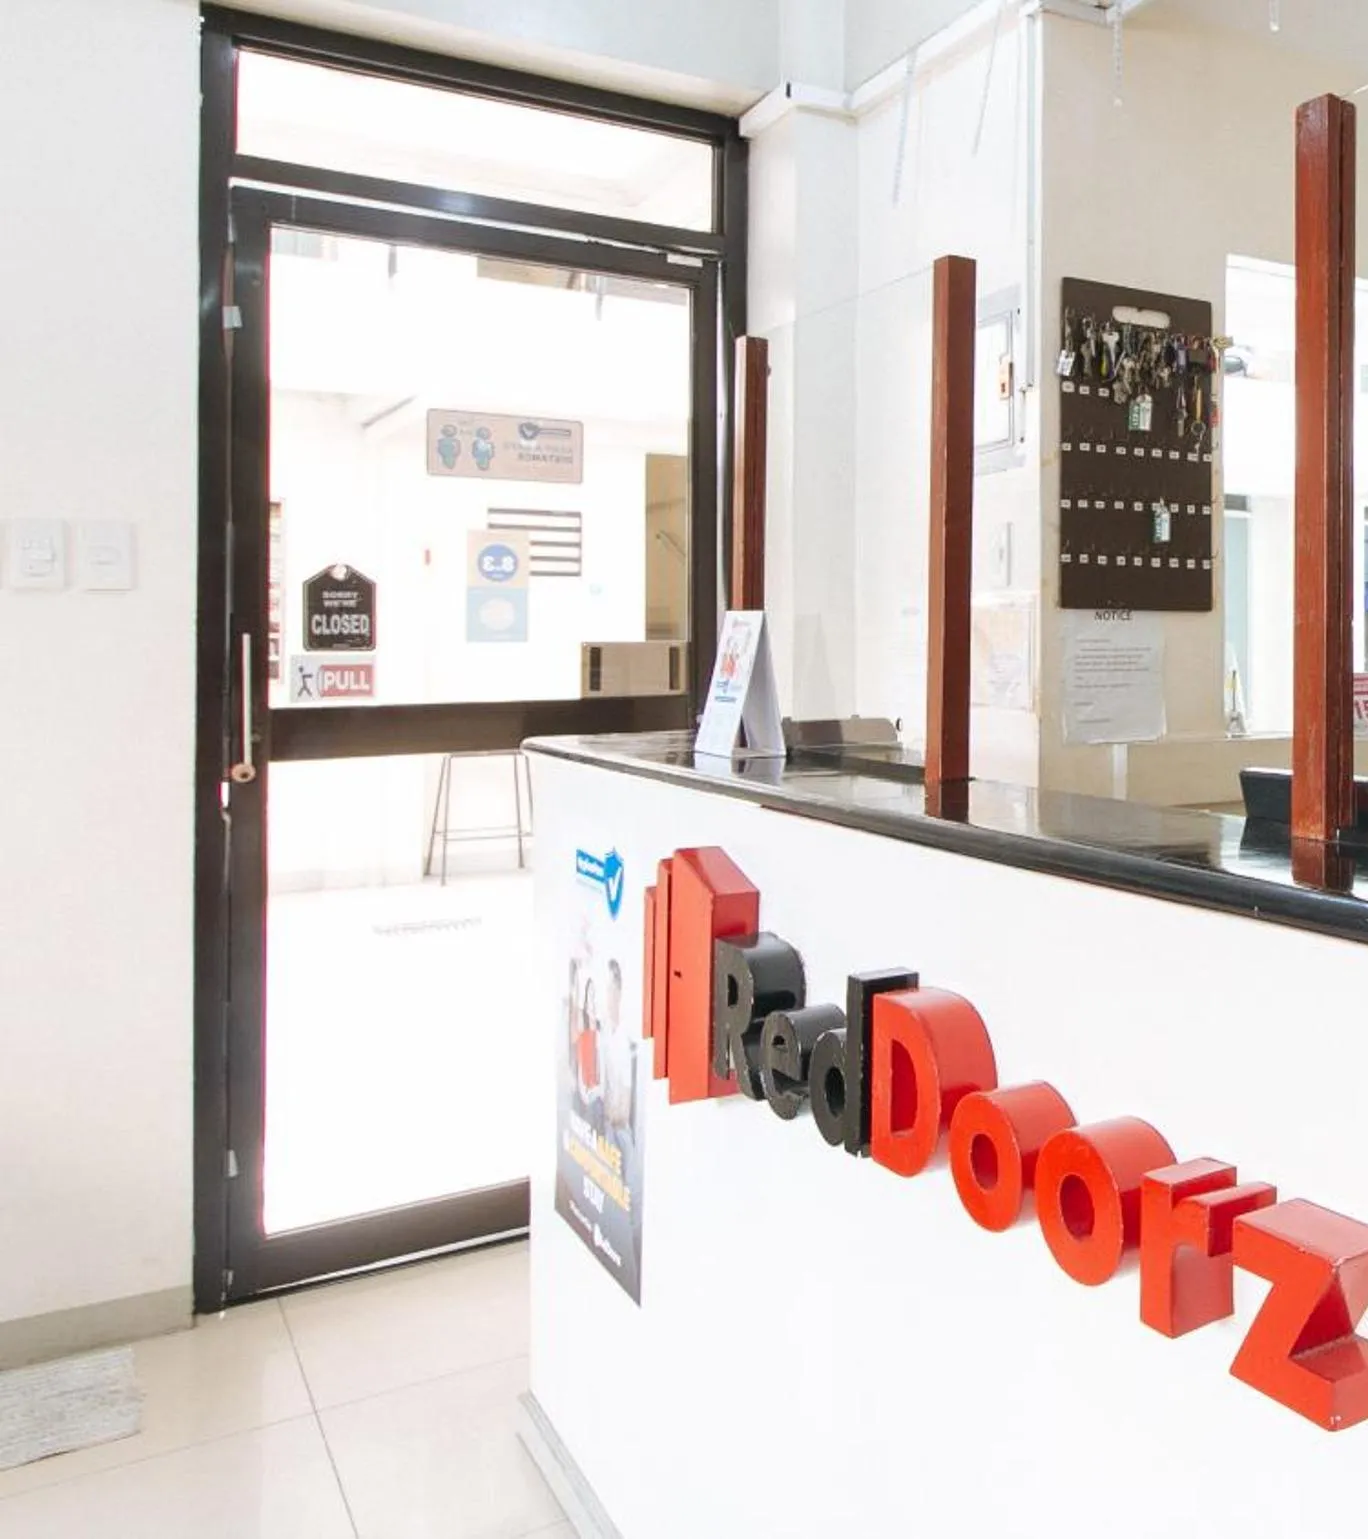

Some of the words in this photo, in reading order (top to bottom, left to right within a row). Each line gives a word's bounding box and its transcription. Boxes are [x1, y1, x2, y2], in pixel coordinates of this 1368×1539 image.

[311, 613, 370, 637] CLOSED
[1094, 609, 1133, 621] NOTICE
[324, 669, 370, 691] PULL
